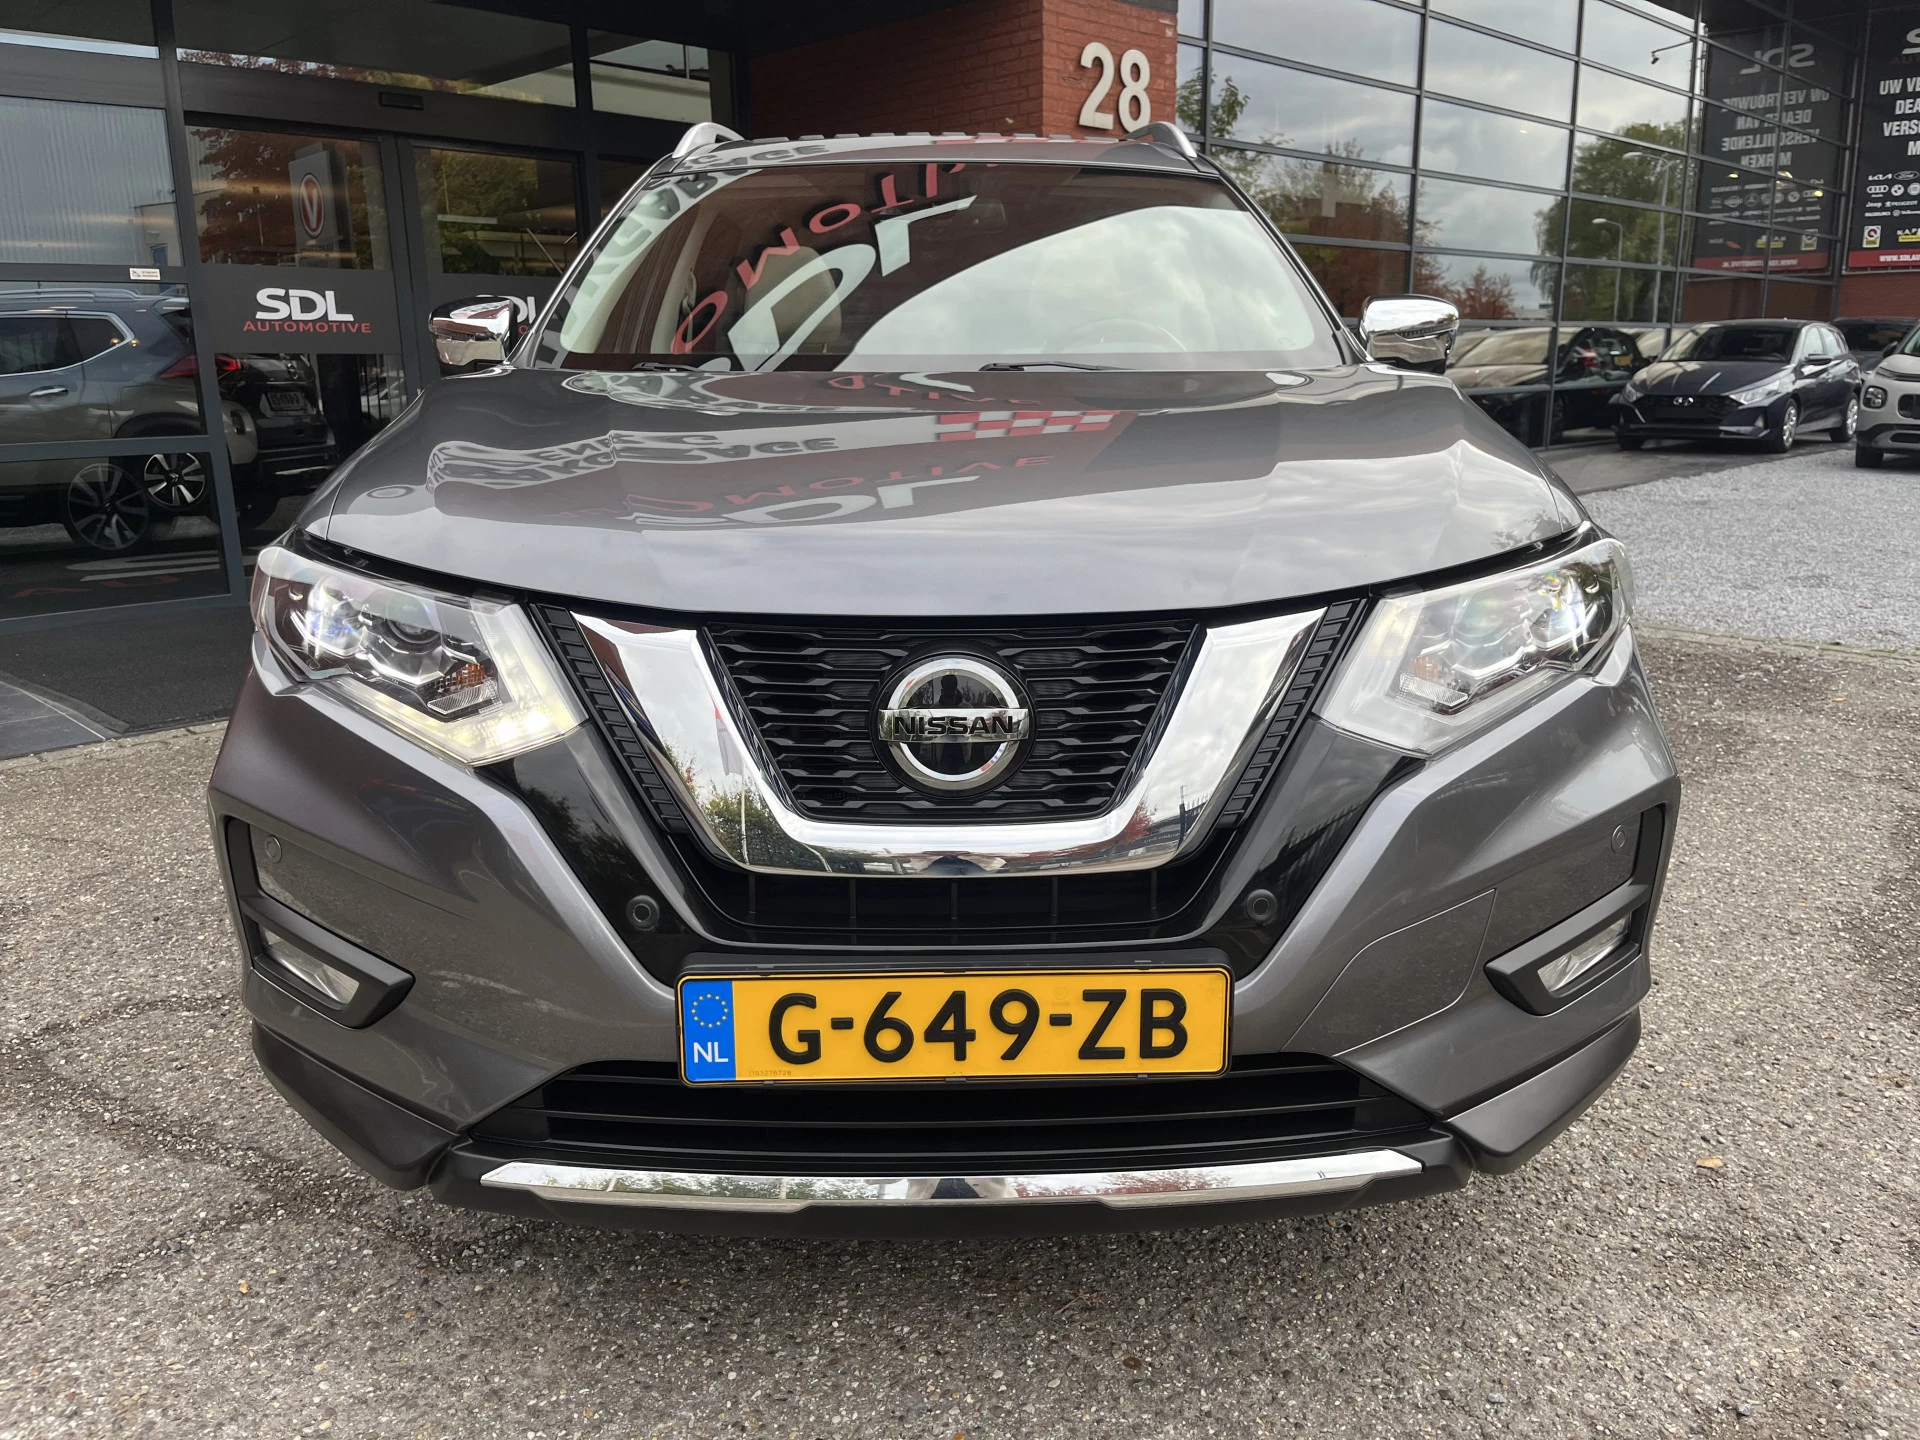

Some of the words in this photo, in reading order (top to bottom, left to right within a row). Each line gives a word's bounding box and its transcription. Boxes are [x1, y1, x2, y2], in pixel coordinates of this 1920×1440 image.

[1079, 42, 1151, 133] 28
[1879, 79, 1903, 95] UW
[1883, 120, 1920, 137] VERS
[256, 287, 354, 322] SDL
[243, 321, 372, 334] AUTOMOTIVE
[895, 716, 1013, 735] NISSAN
[768, 988, 1189, 1065] G-649-ZB
[693, 1042, 729, 1063] NL
